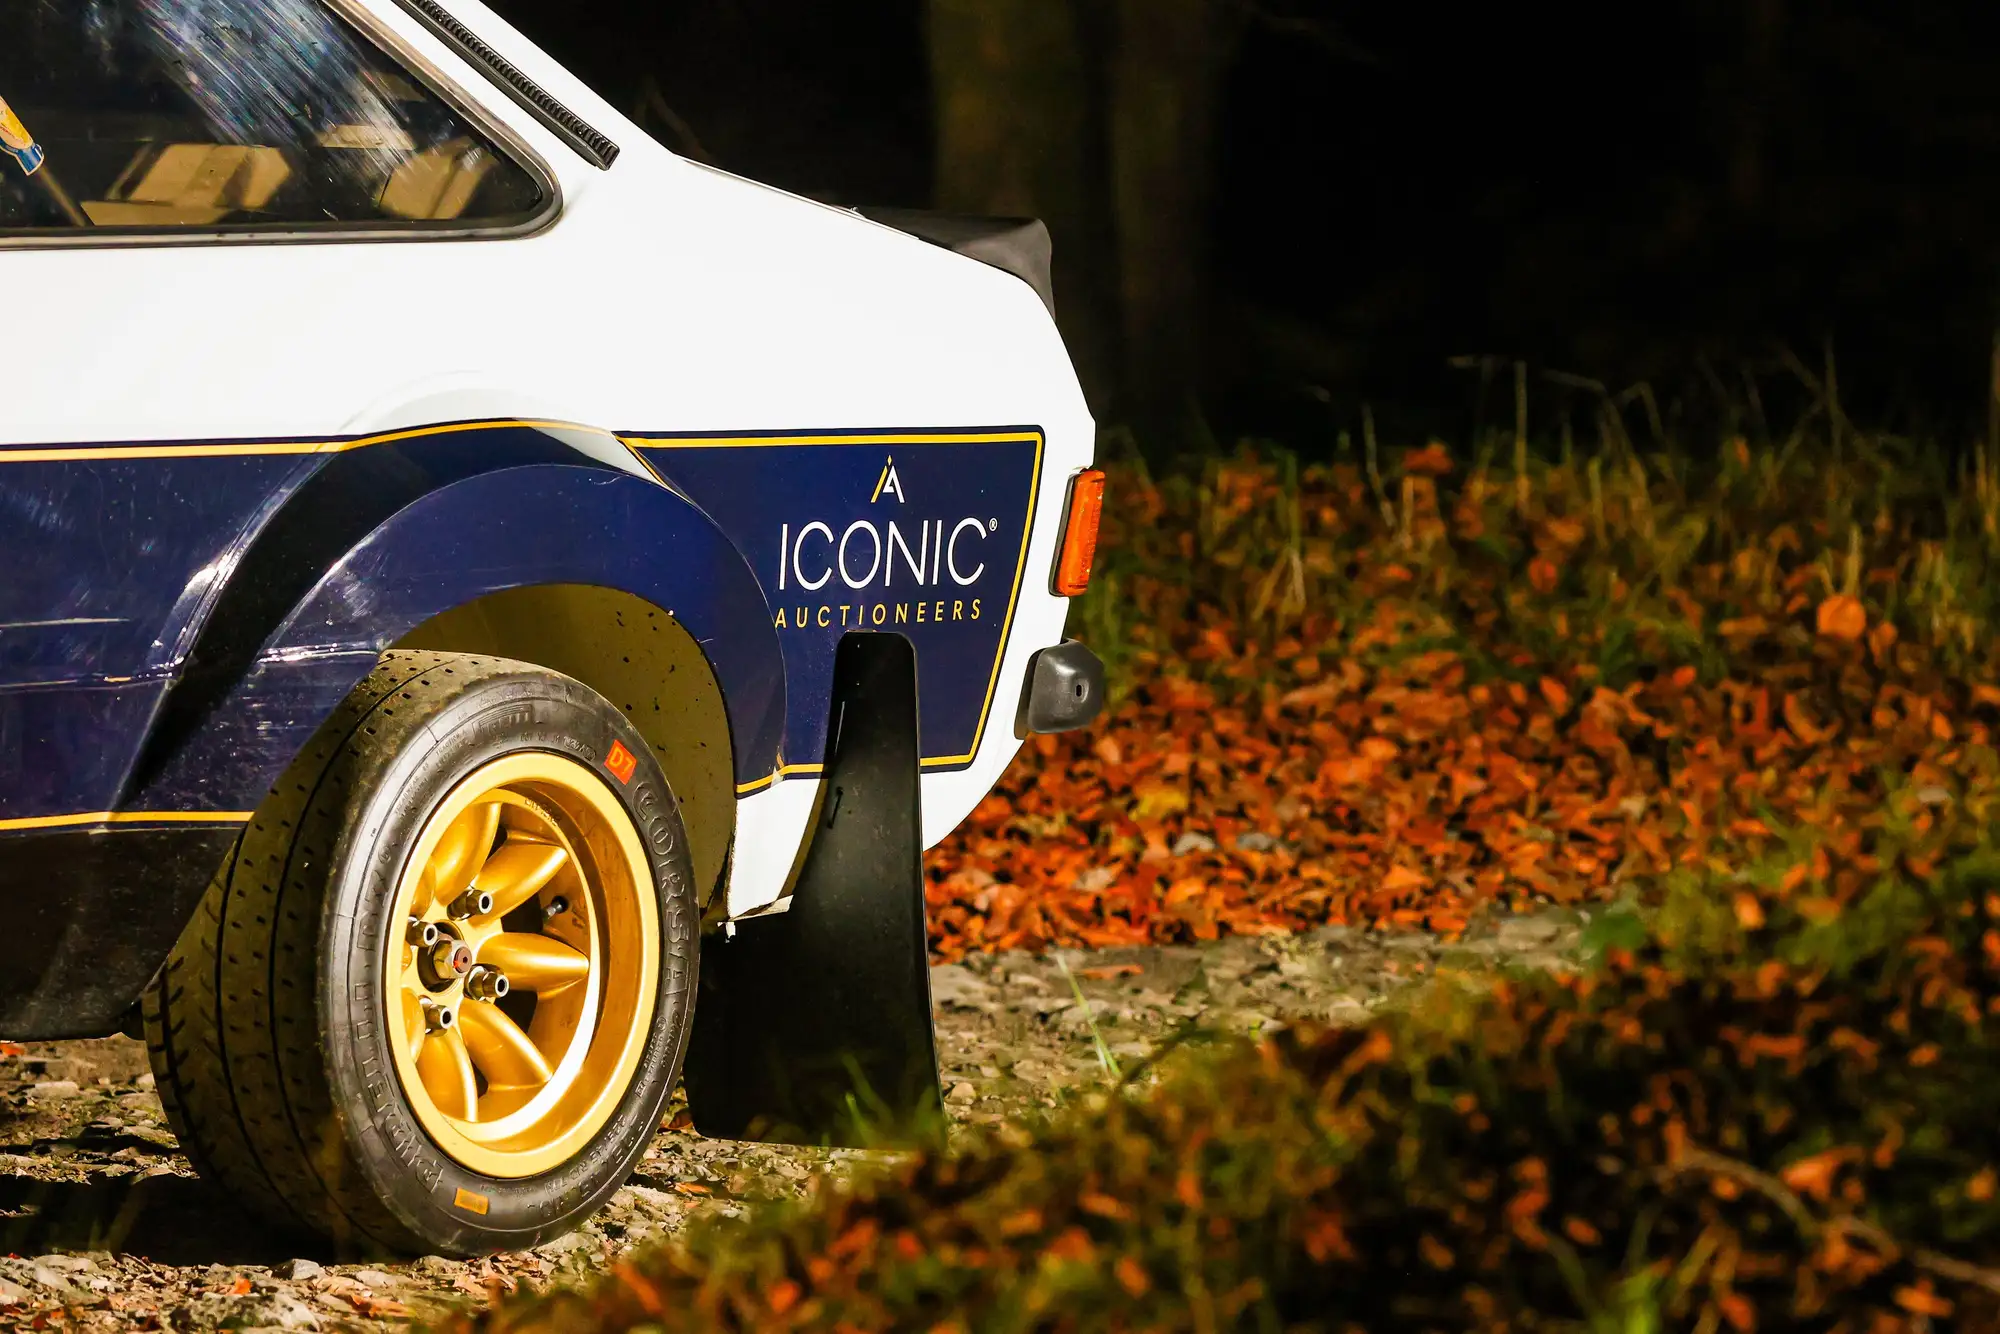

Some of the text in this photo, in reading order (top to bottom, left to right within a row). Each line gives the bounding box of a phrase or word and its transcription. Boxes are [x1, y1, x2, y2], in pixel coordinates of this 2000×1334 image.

[774, 599, 981, 629] AUCTIONEERS
[608, 746, 634, 777] D7
[632, 781, 688, 994] CORSA
[354, 982, 444, 1193] PIRELLI
